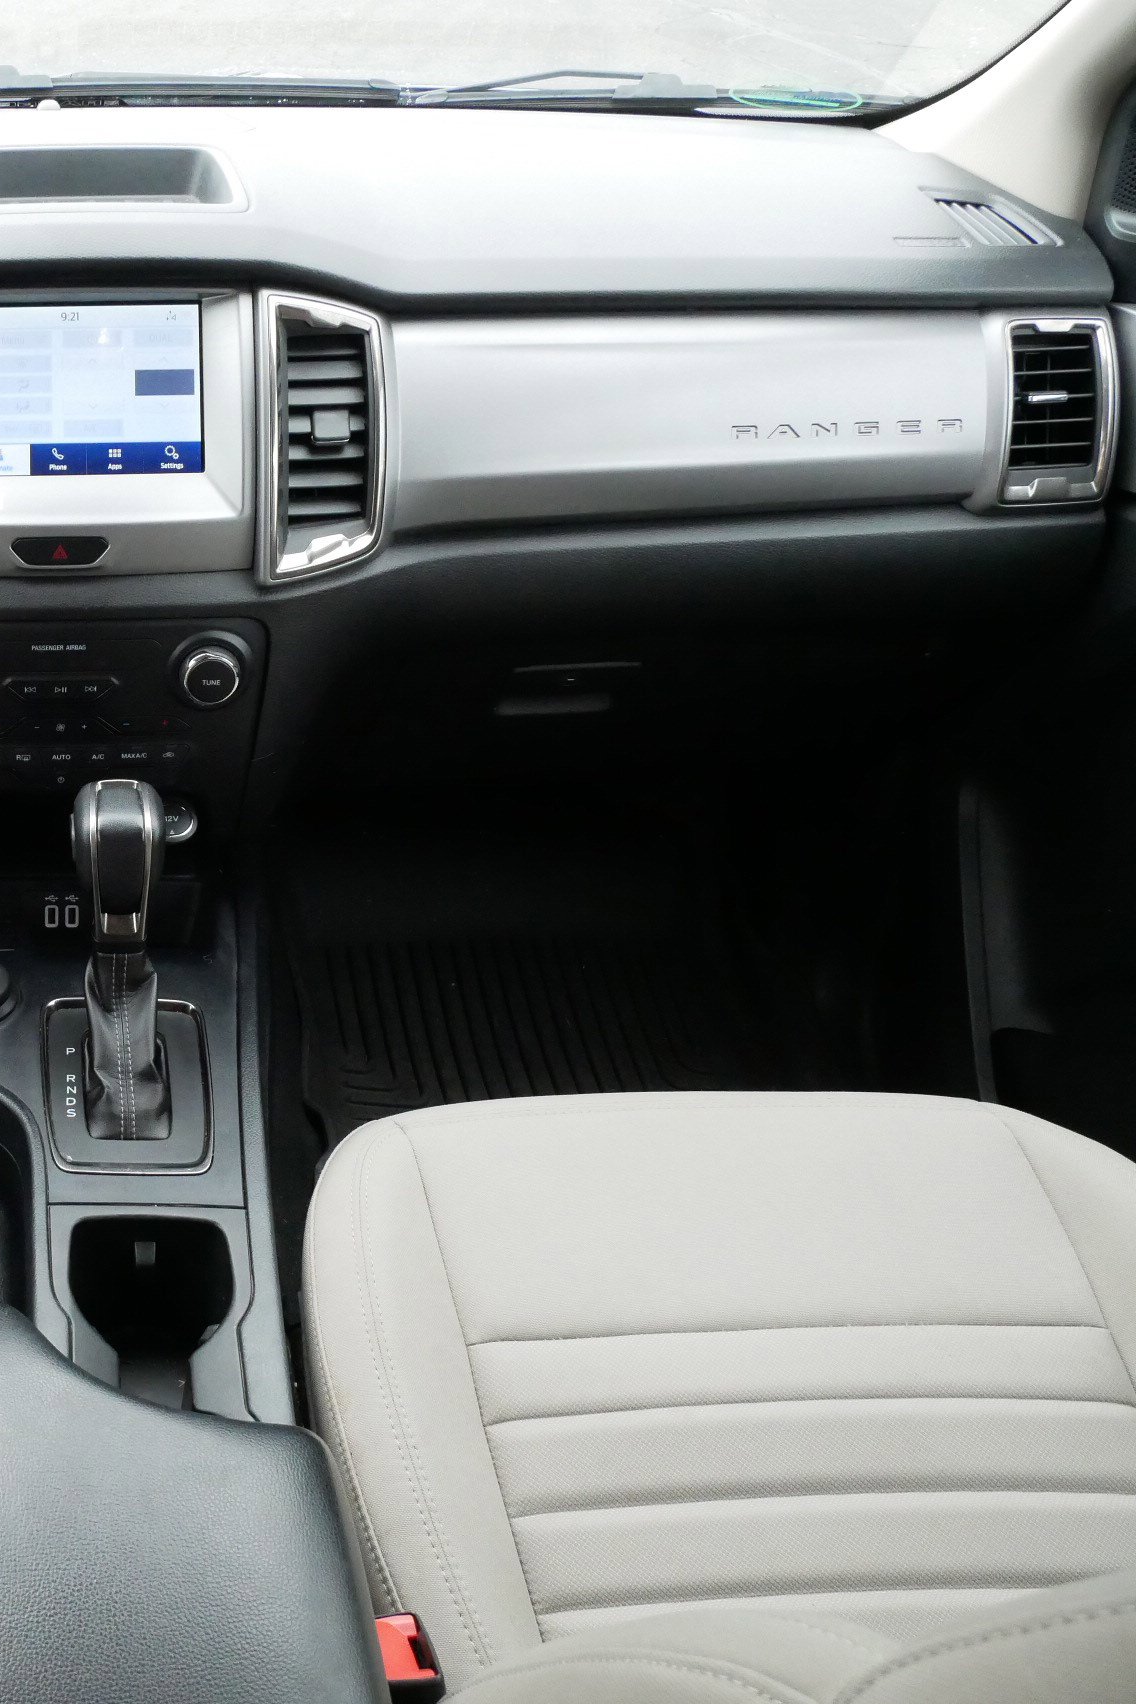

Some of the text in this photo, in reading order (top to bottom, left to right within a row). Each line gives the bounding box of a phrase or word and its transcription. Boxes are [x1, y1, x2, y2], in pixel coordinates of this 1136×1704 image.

[60, 312, 80, 321] 9:21
[731, 418, 963, 440] RANGER
[107, 463, 122, 471] Apps
[160, 462, 184, 470] Settings
[66, 1074, 76, 1082] R
[66, 1086, 76, 1094] N
[66, 1097, 76, 1106] D
[66, 1108, 76, 1118] S
